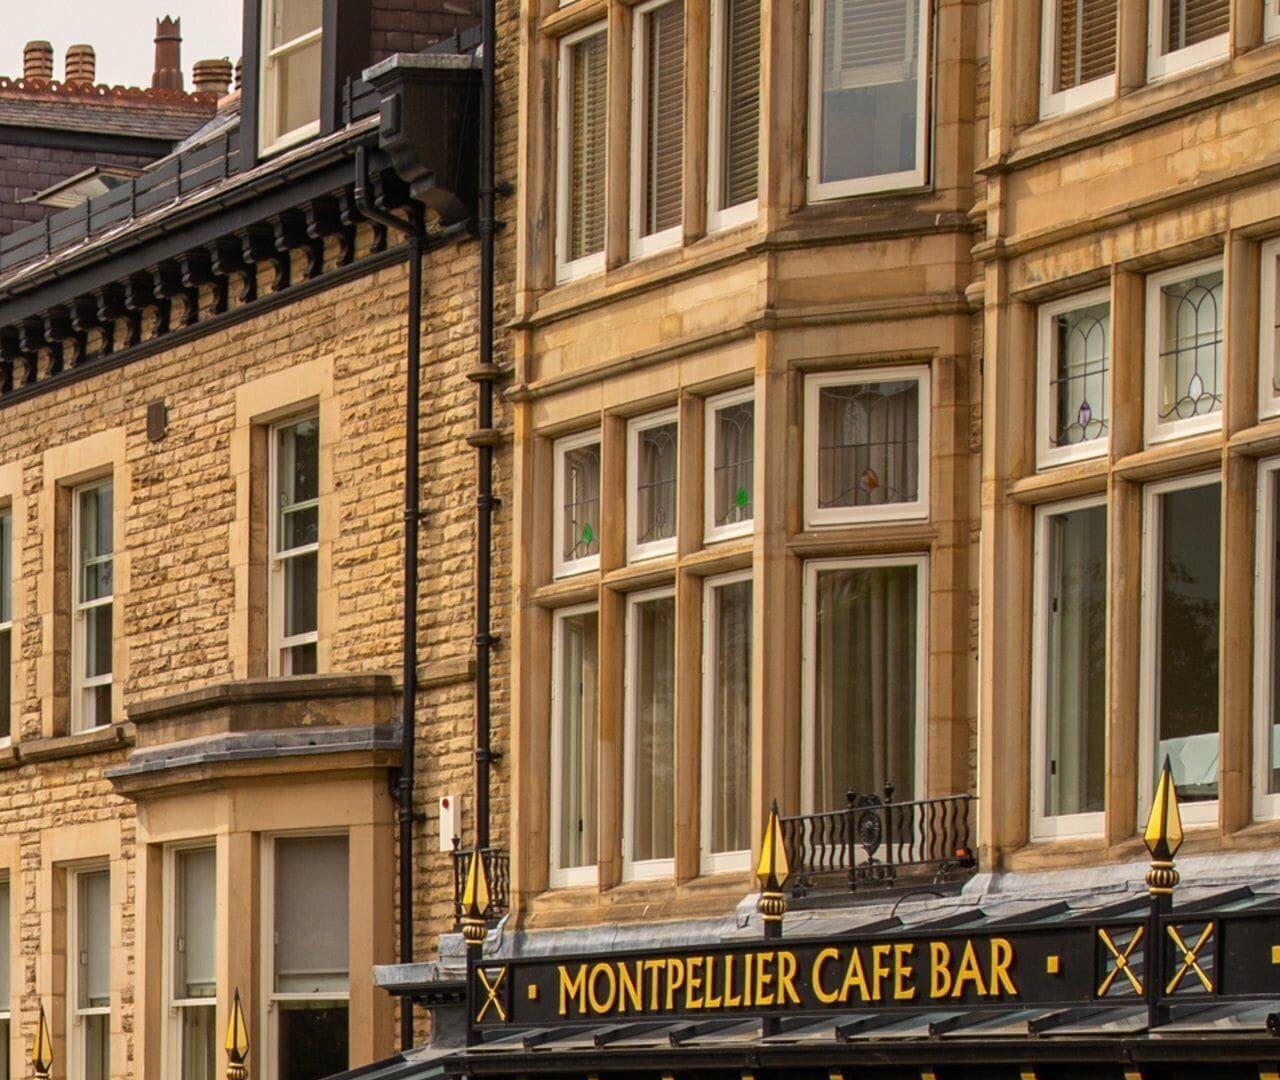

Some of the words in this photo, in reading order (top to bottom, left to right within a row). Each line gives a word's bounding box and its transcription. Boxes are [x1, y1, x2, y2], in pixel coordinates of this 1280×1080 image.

[557, 949, 801, 1016] MONTPELLIER
[811, 946, 917, 1005] CAFE
[930, 937, 1018, 999] BAR
